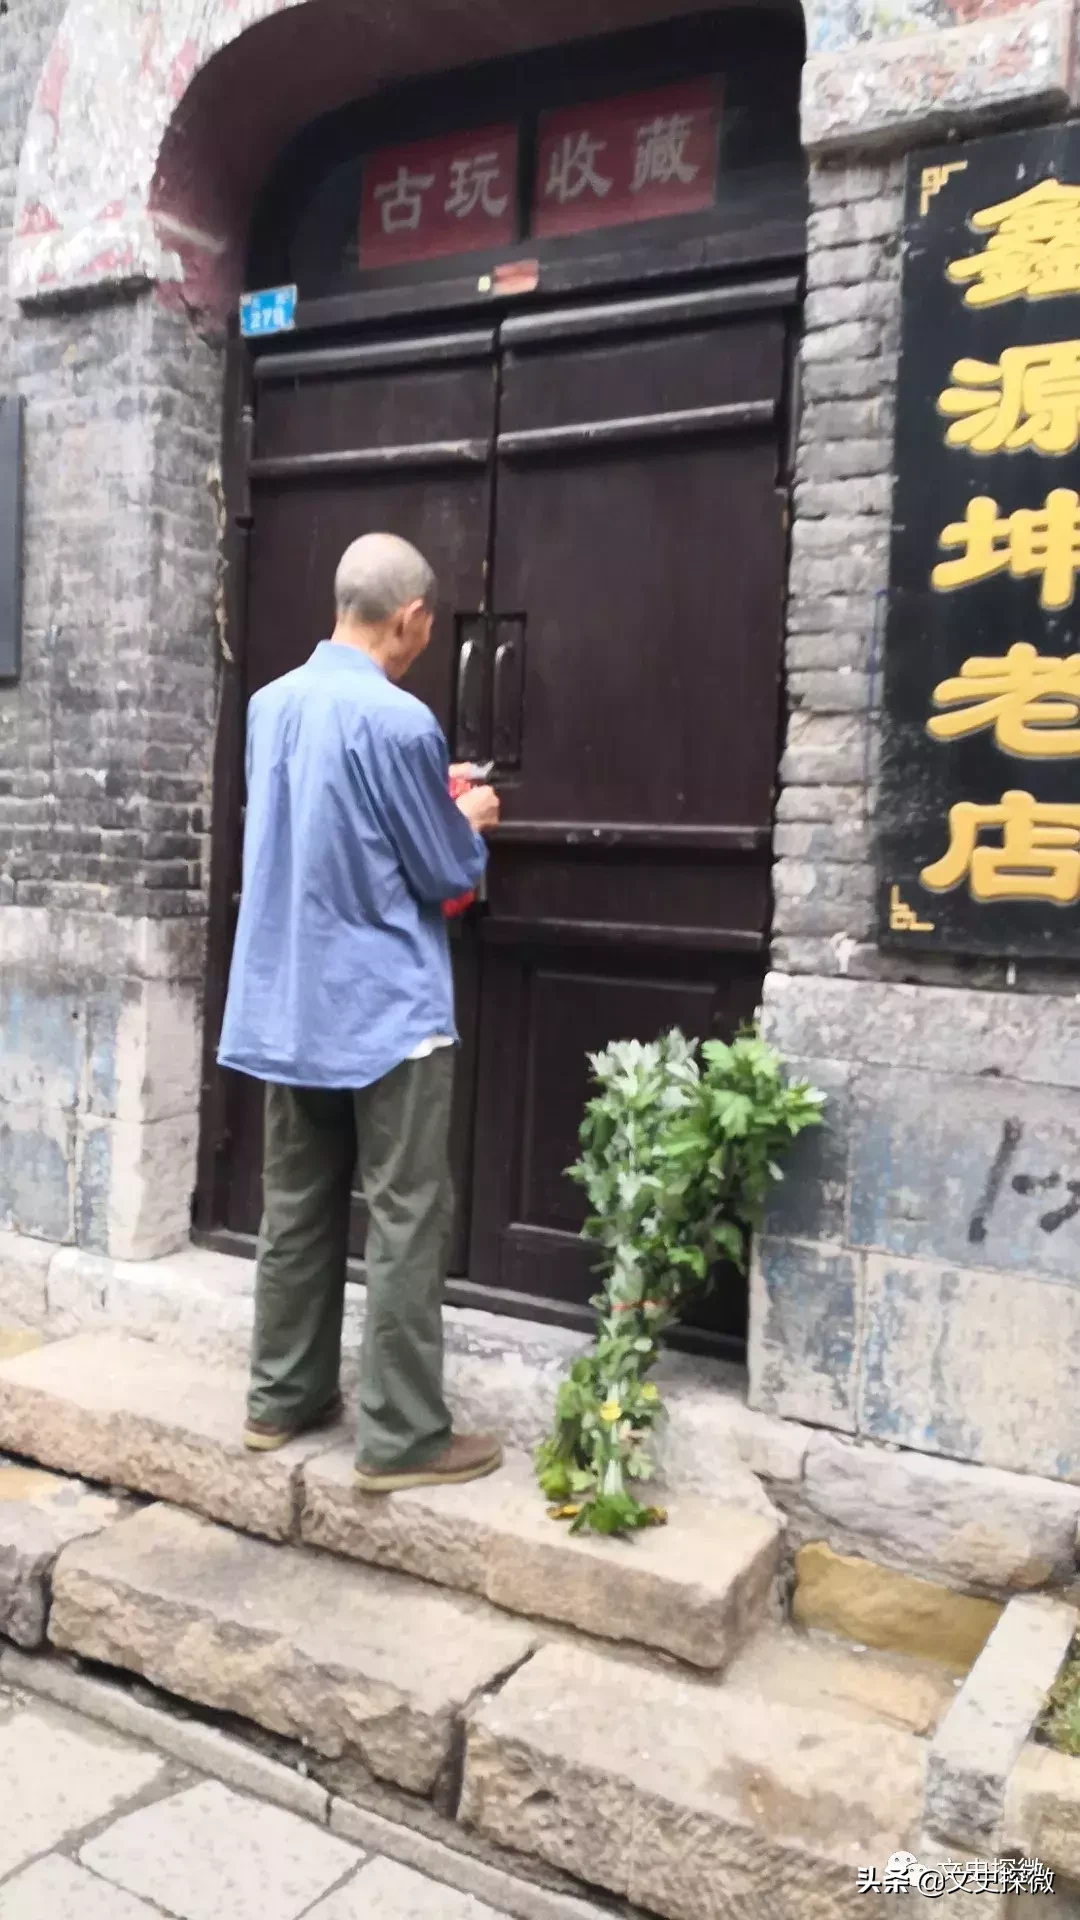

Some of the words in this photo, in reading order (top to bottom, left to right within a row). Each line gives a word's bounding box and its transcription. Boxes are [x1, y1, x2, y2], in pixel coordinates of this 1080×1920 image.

[373, 151, 509, 234] 古玩
[544, 112, 701, 205] 收藏
[919, 178, 1080, 904] 鑫源坤老店
